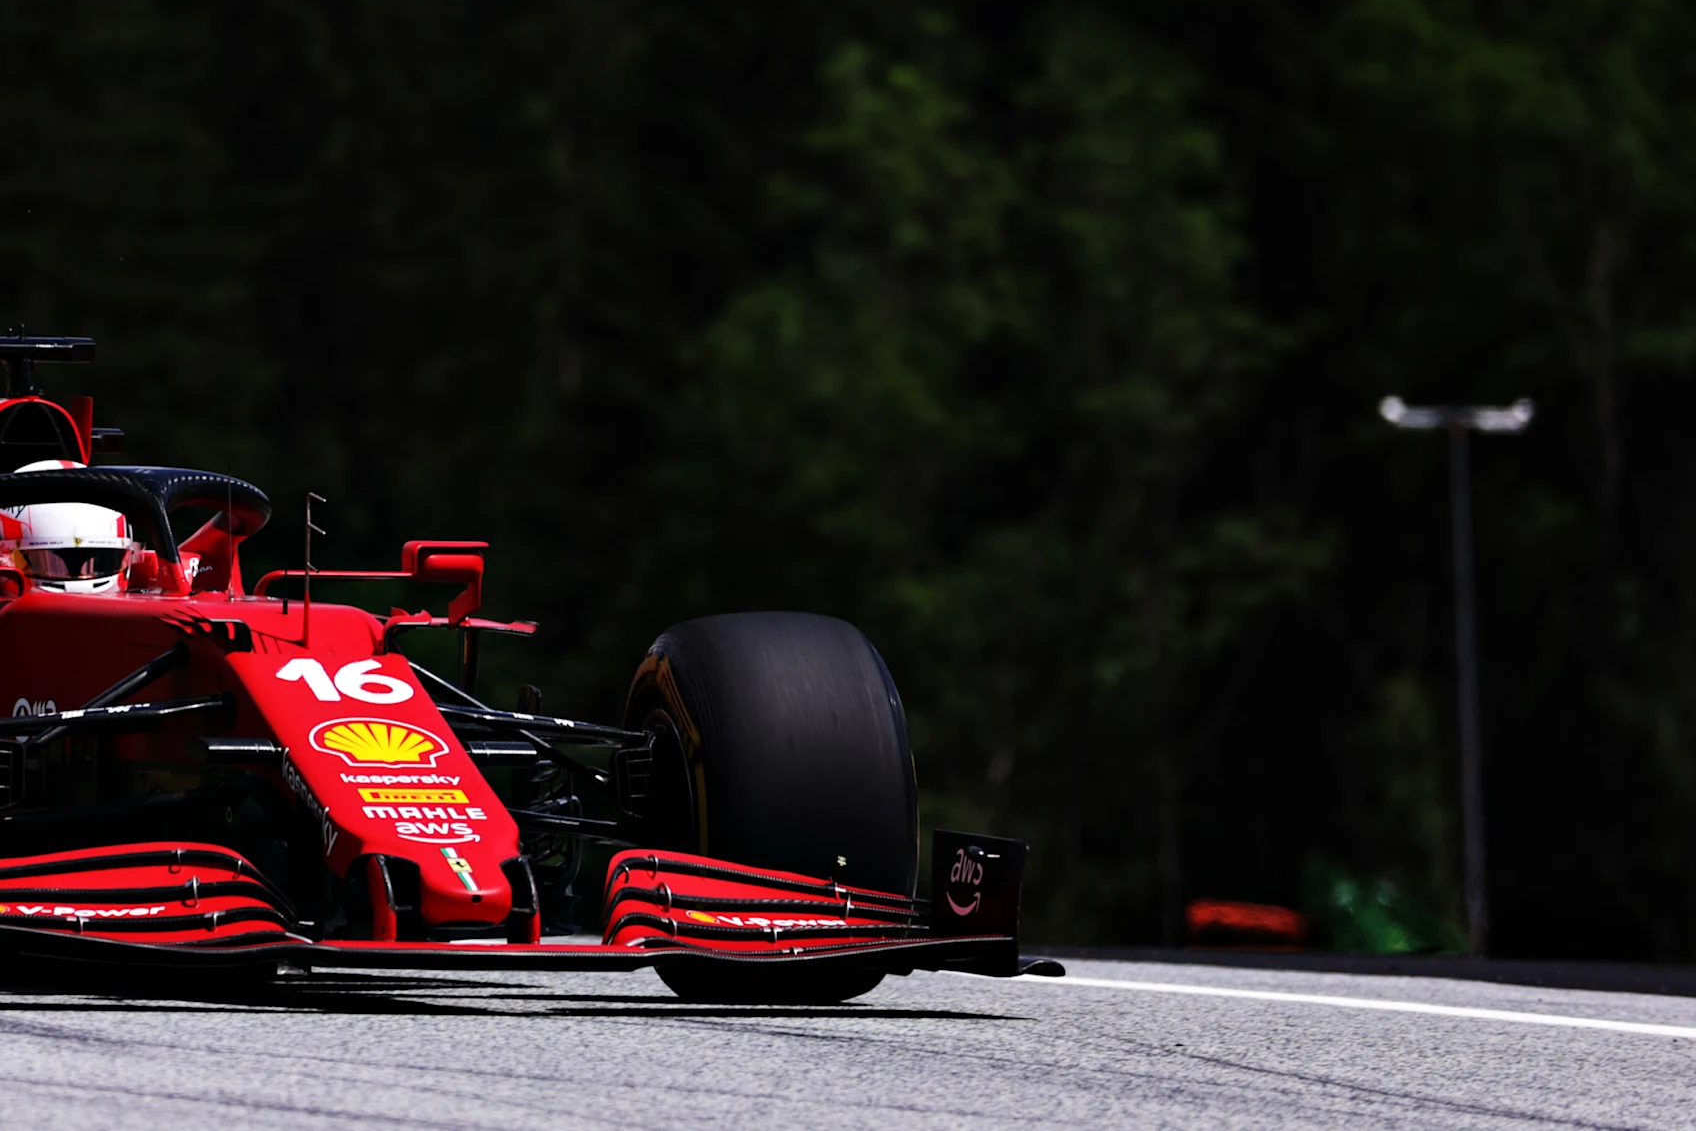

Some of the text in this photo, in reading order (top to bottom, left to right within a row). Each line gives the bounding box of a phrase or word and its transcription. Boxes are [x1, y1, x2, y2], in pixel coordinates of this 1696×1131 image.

[275, 658, 414, 704] 16
[340, 773, 460, 785] kaspersky
[362, 806, 487, 820] MAHLE
[394, 822, 473, 835] aws
[951, 848, 983, 885] aws
[17, 905, 165, 917] V-Power
[717, 915, 846, 926] V-Power
